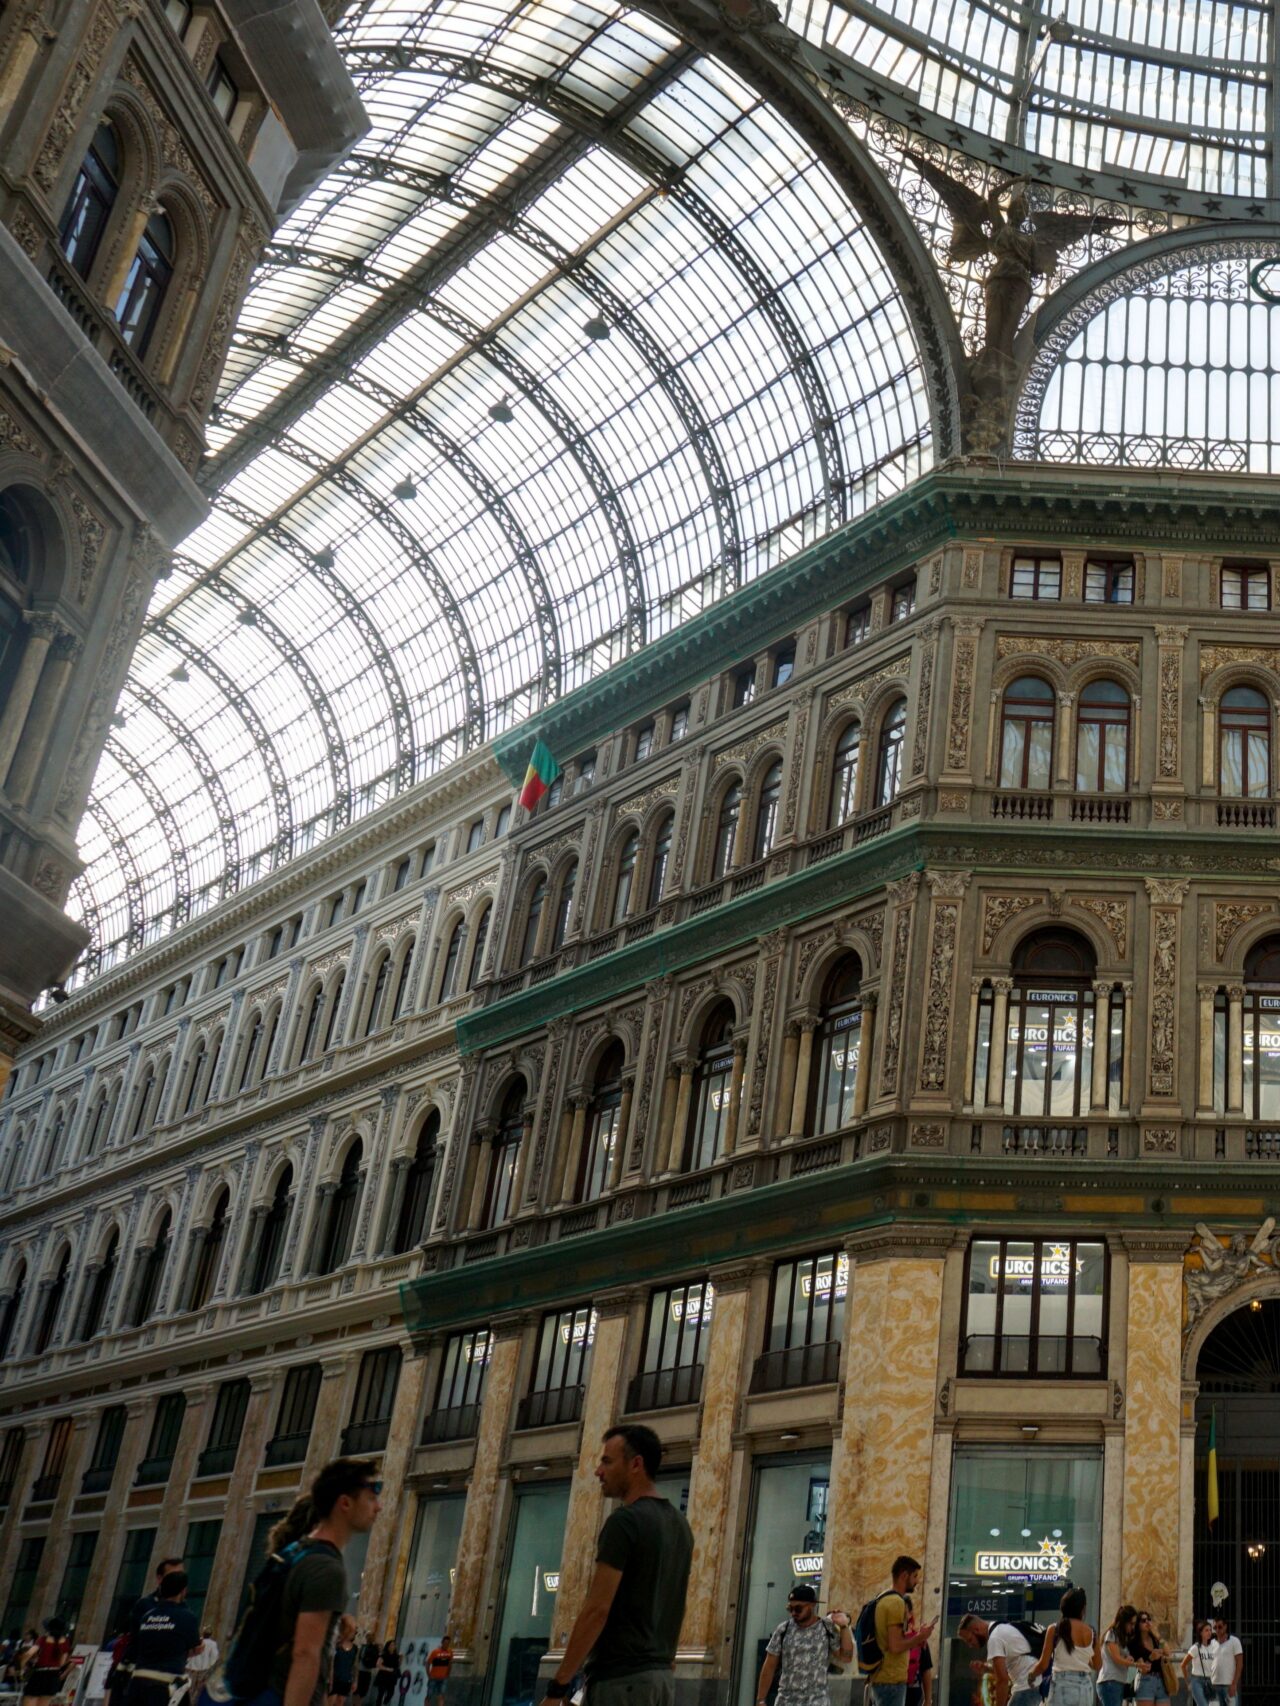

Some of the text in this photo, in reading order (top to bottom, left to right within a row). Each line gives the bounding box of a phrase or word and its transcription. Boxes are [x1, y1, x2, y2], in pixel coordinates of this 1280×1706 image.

[1031, 993, 1075, 1002] EURONICS
[980, 1556, 1059, 1571] EURONICS
[967, 1599, 998, 1612] CASSE
[147, 1615, 170, 1623] Polizia
